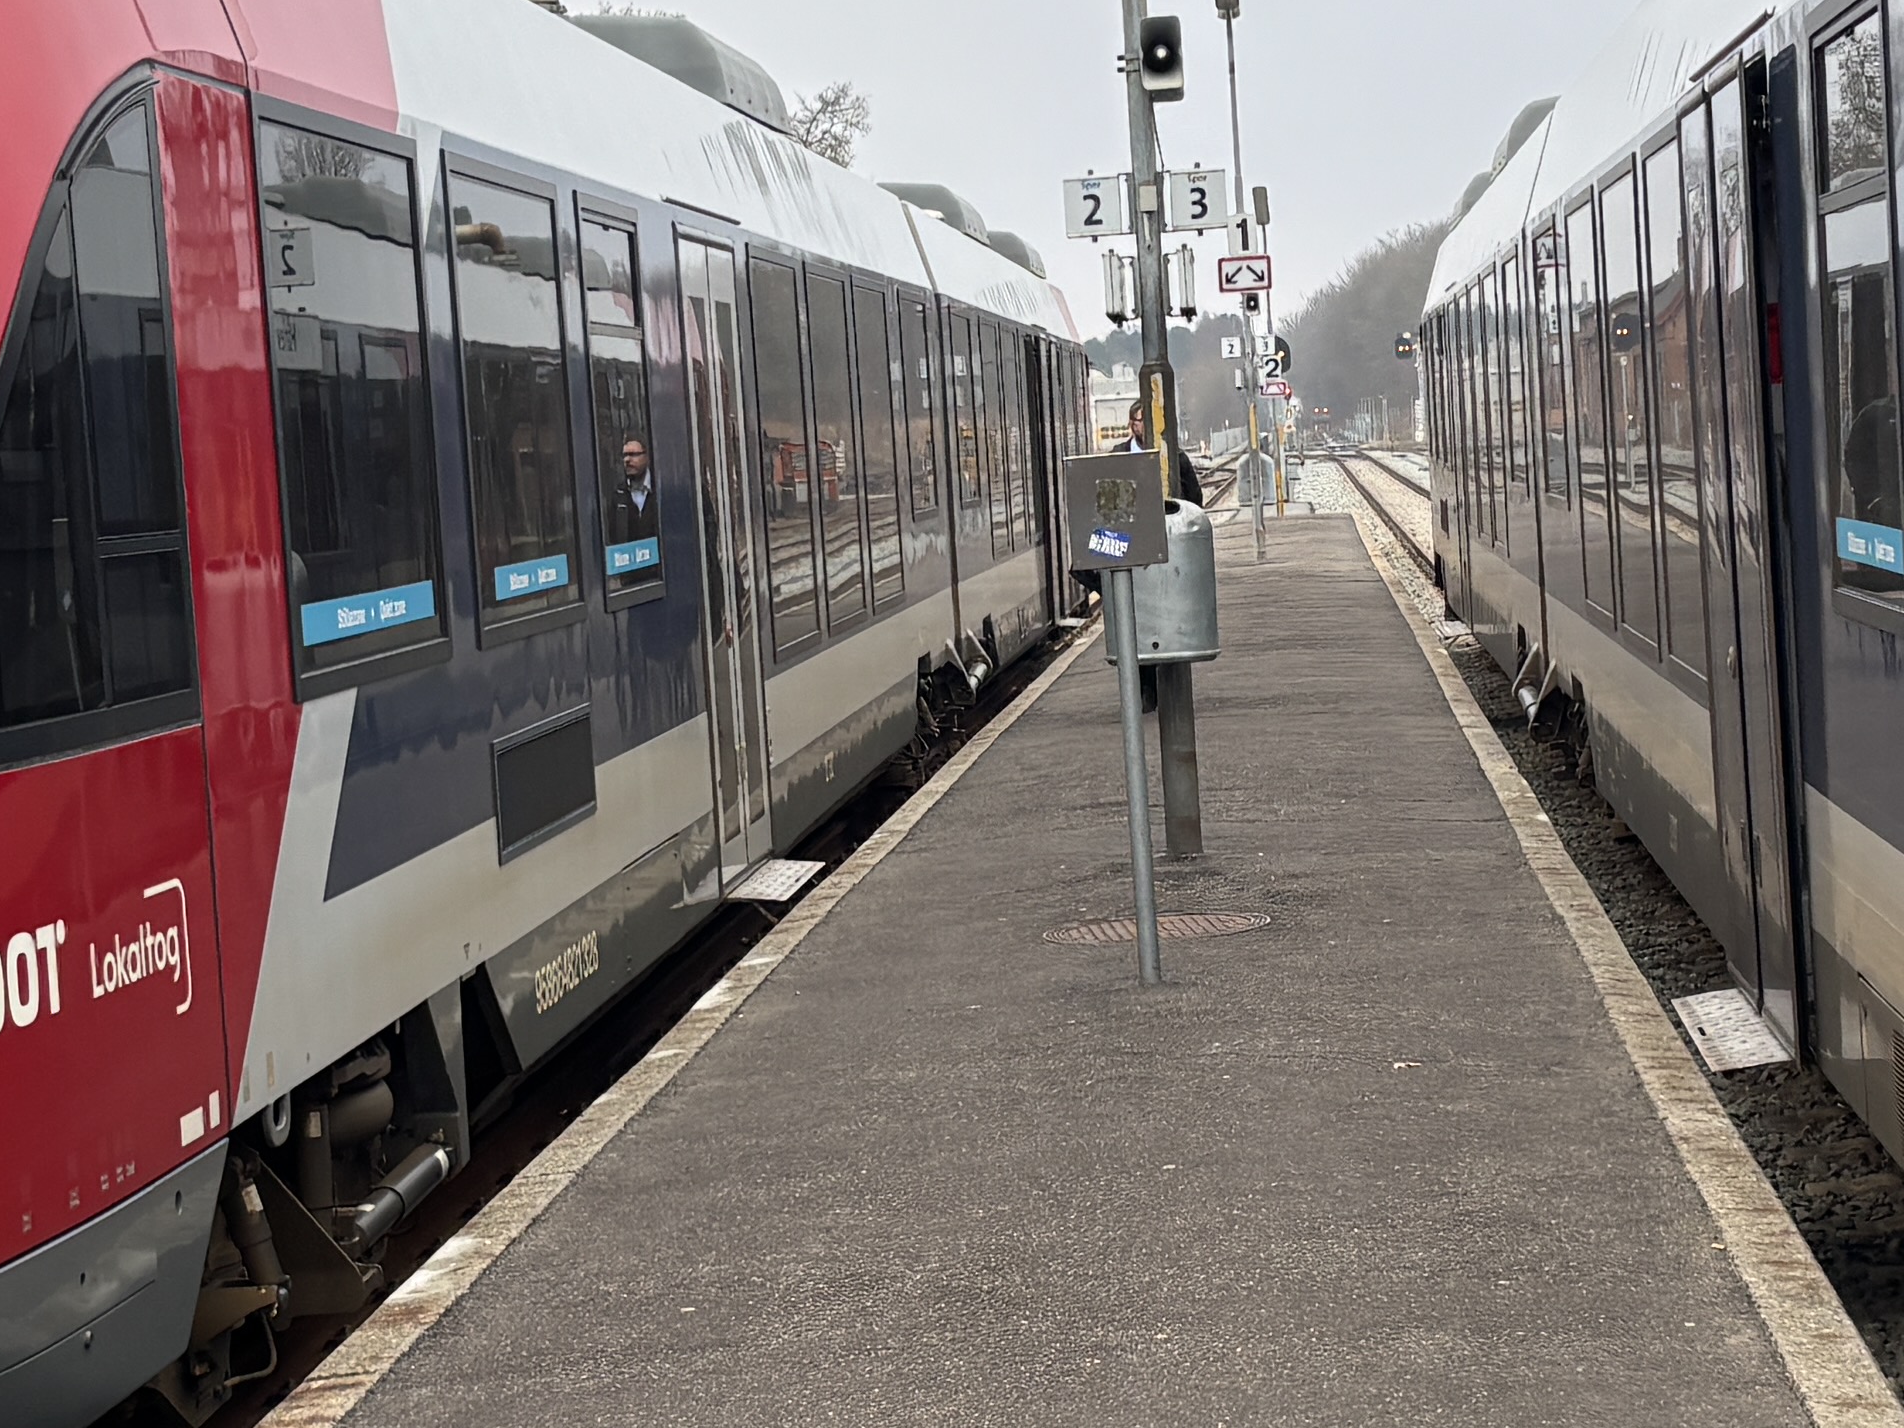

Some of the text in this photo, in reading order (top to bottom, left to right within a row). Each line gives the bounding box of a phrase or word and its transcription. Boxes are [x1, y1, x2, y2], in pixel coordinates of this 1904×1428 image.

[1083, 194, 1103, 226] 2
[1190, 187, 1208, 220] 3
[1236, 218, 1250, 252] 1
[1265, 358, 1279, 378] 2
[90, 921, 181, 999] Lokaltog
